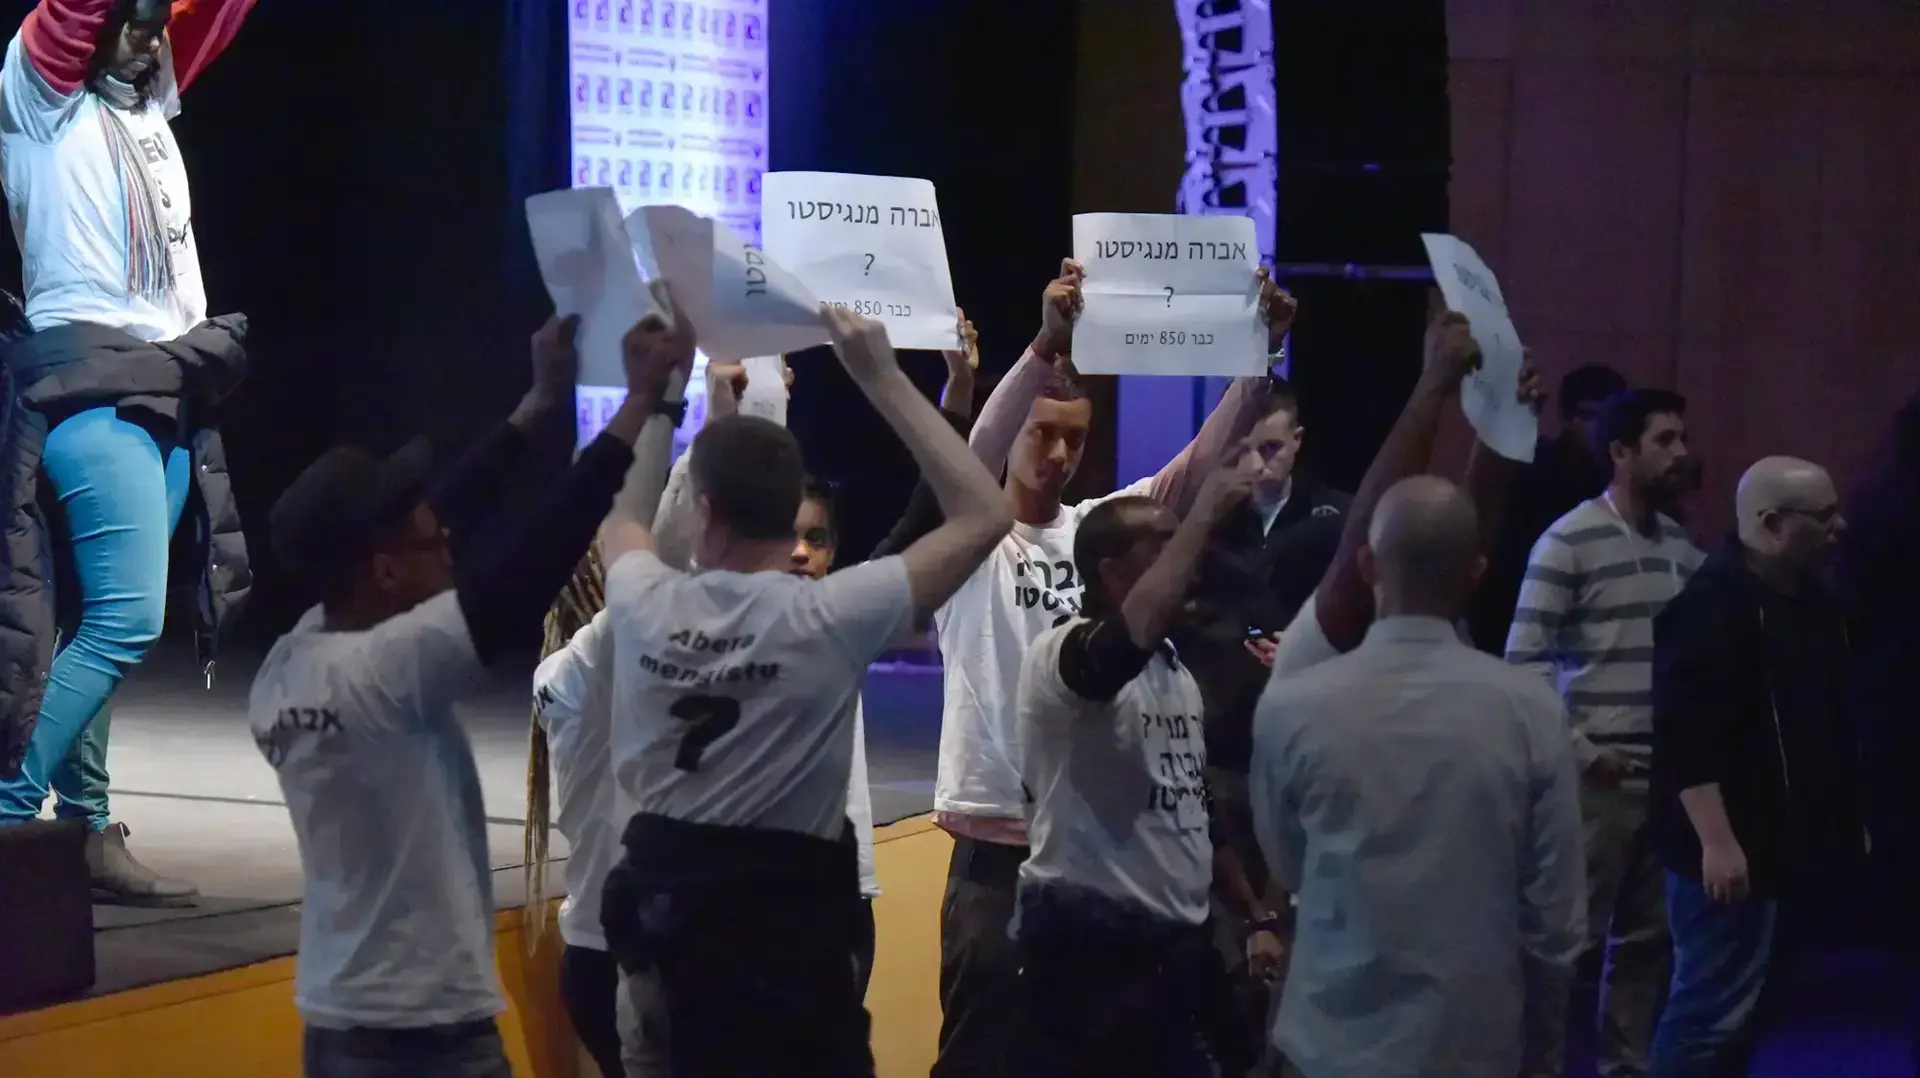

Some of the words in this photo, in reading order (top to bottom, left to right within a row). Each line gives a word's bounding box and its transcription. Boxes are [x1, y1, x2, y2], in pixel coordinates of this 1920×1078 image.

[787, 200, 879, 224] מנגיסטו
[890, 207, 940, 228] אברה
[1096, 241, 1178, 259] מנגיסטו
[1188, 242, 1246, 260] אברה
[863, 253, 875, 276] ?
[1164, 286, 1175, 308] ?
[854, 300, 882, 315] 850
[887, 304, 911, 316] כבר
[1125, 332, 1154, 345] ימים
[1159, 331, 1186, 345] 850
[1191, 333, 1214, 345] כבר
[1016, 553, 1085, 591] ברה
